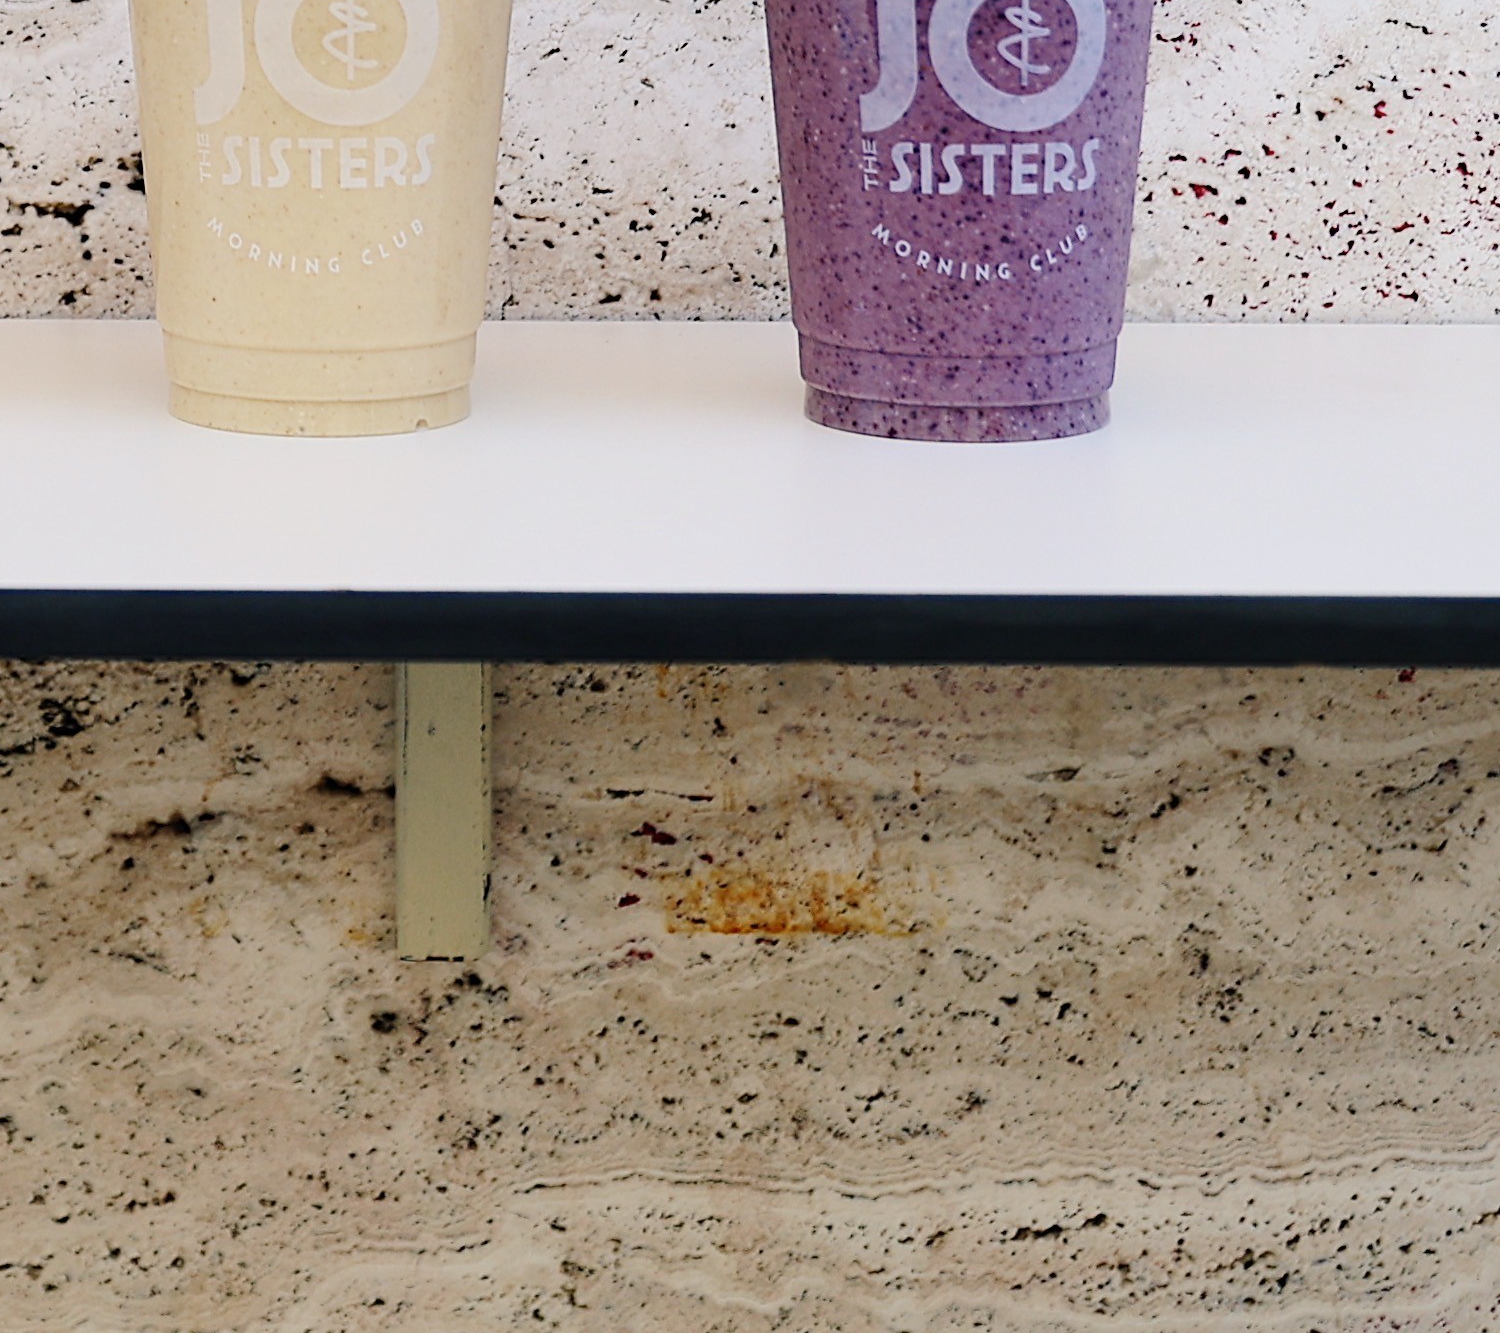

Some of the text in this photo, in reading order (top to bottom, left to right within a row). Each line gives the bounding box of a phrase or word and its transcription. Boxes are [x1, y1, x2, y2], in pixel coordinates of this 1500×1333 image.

[198, 133, 436, 189] THE SISTERS
[861, 138, 1100, 196] THE SISTERS
[207, 217, 424, 274] MORNING CLUB
[871, 223, 1087, 281] MORNING CLUB
